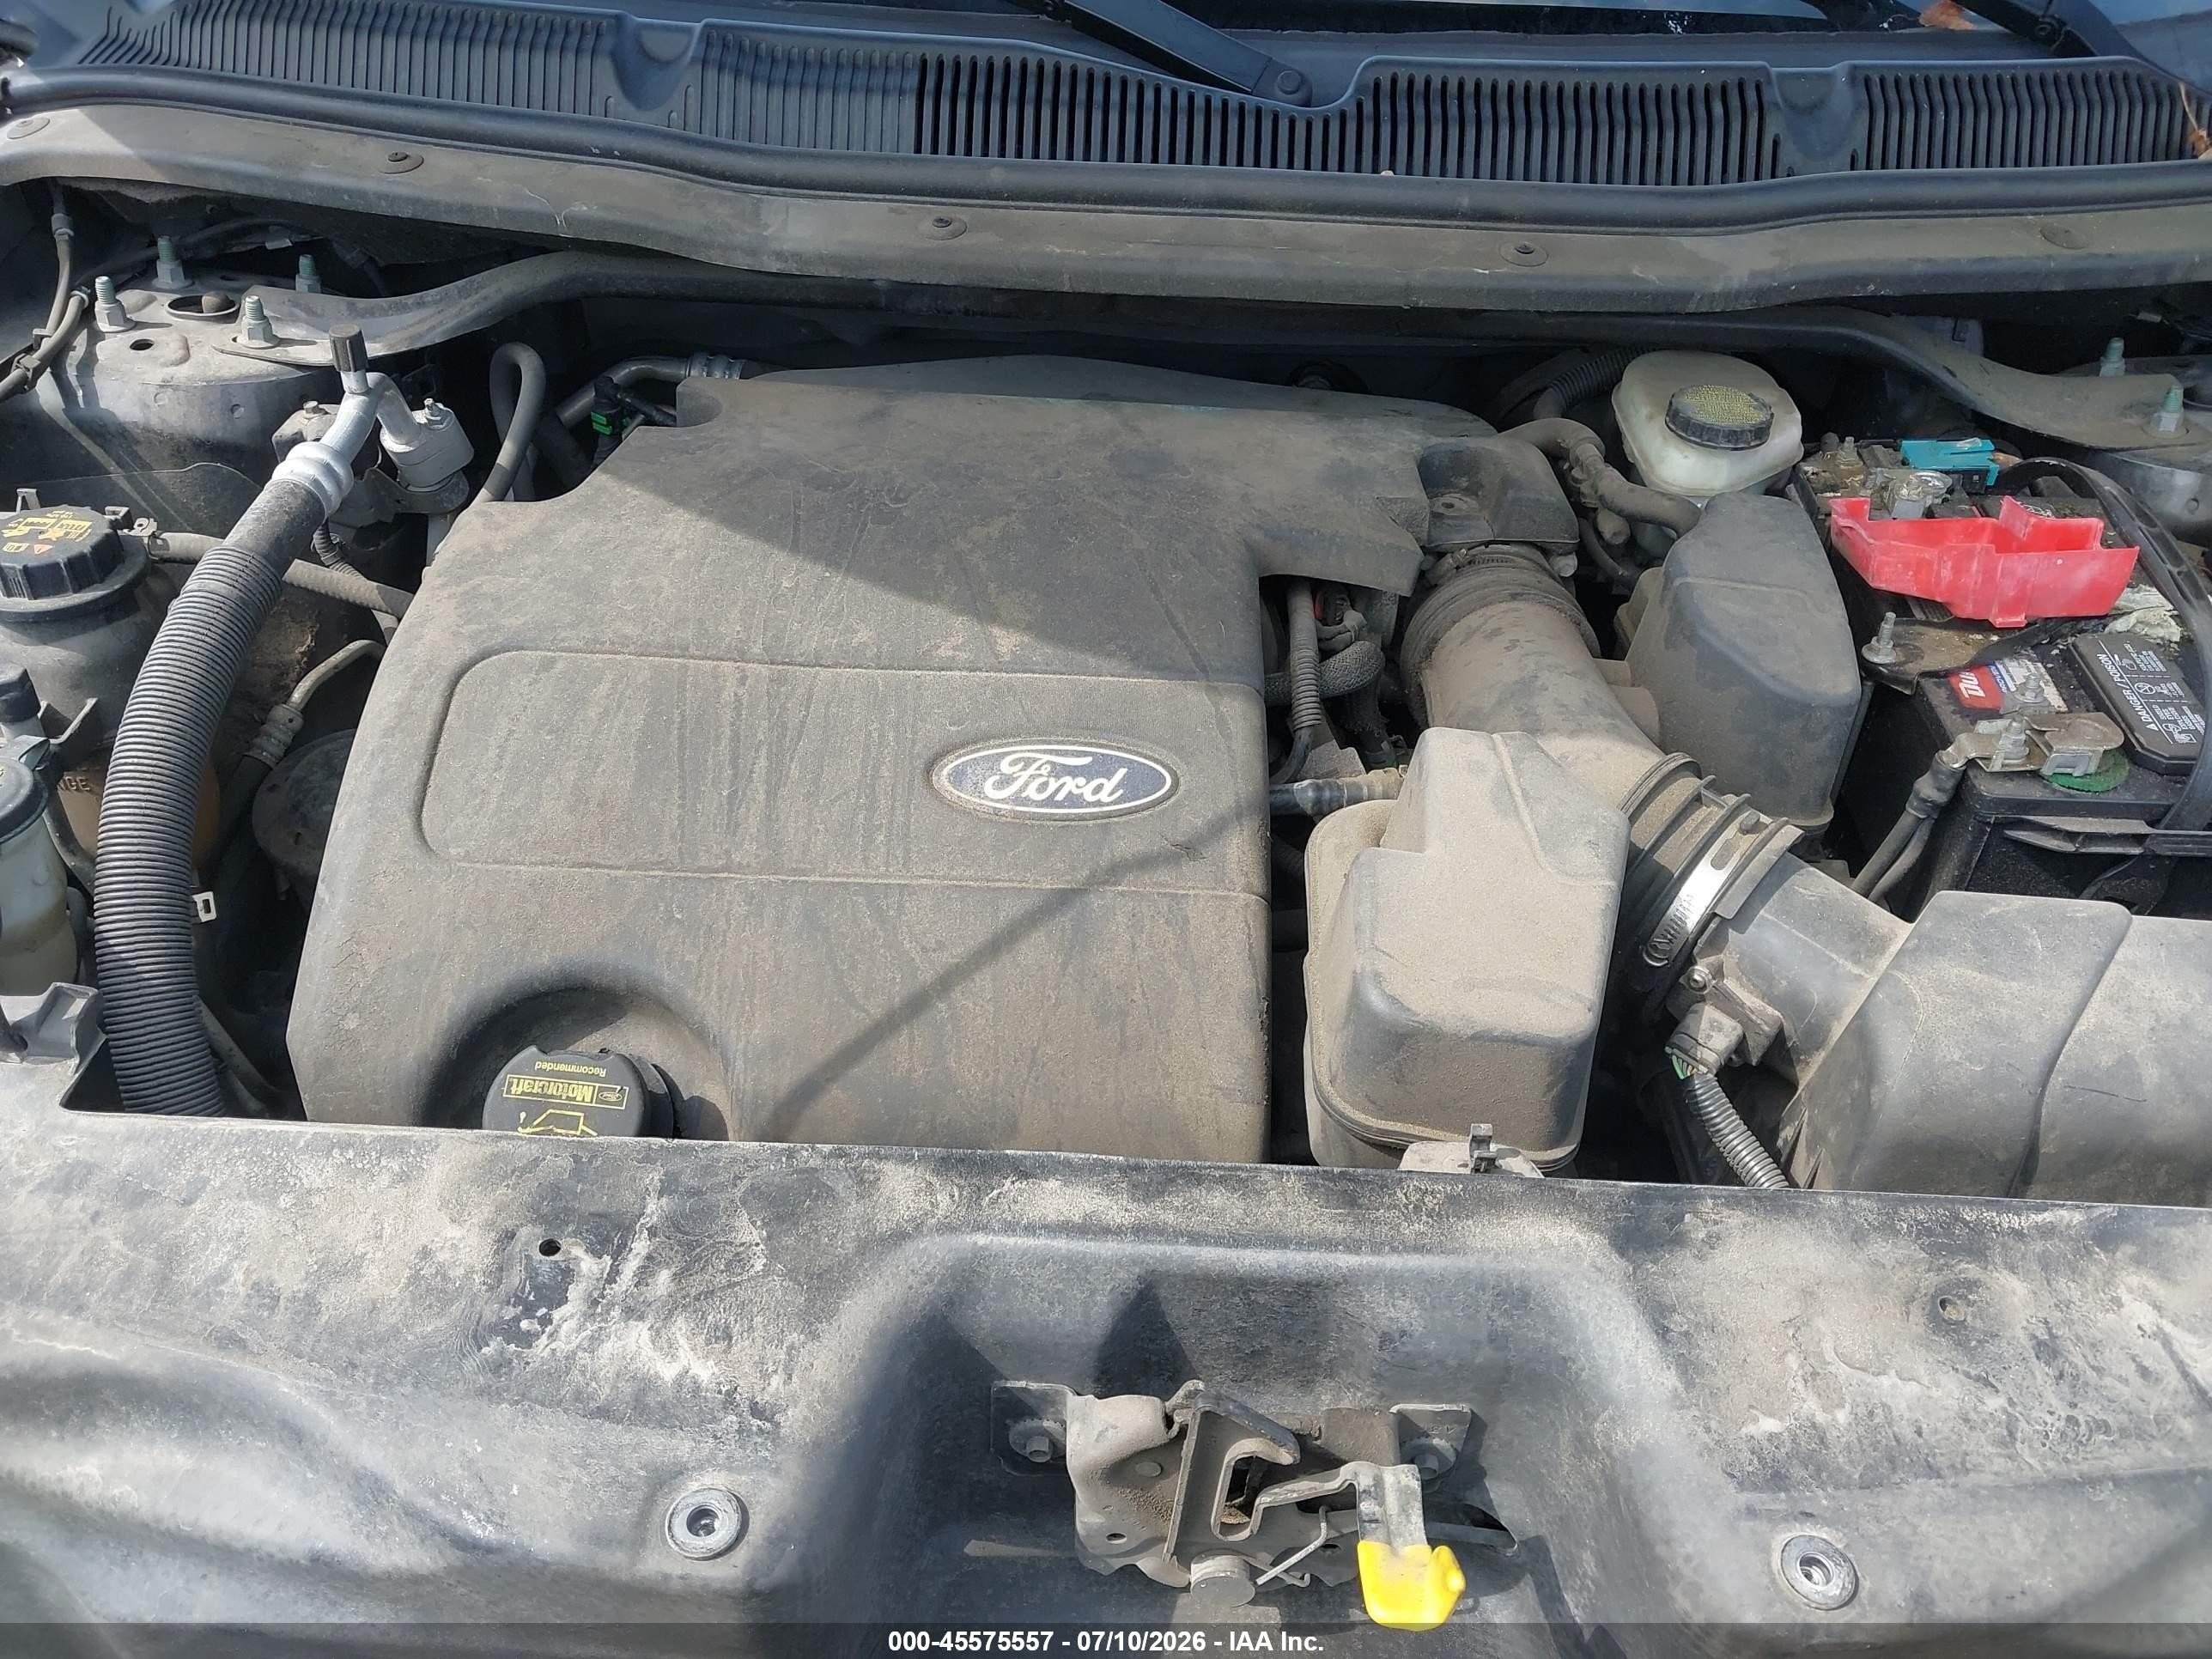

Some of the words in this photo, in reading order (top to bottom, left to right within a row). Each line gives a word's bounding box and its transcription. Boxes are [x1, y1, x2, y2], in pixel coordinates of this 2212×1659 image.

[2096, 653, 2126, 684] POISON
[2123, 690, 2154, 723] DANGER
[983, 752, 1128, 803] Ford
[534, 1060, 607, 1078] Recommended
[510, 1078, 594, 1103] Motorcraft
